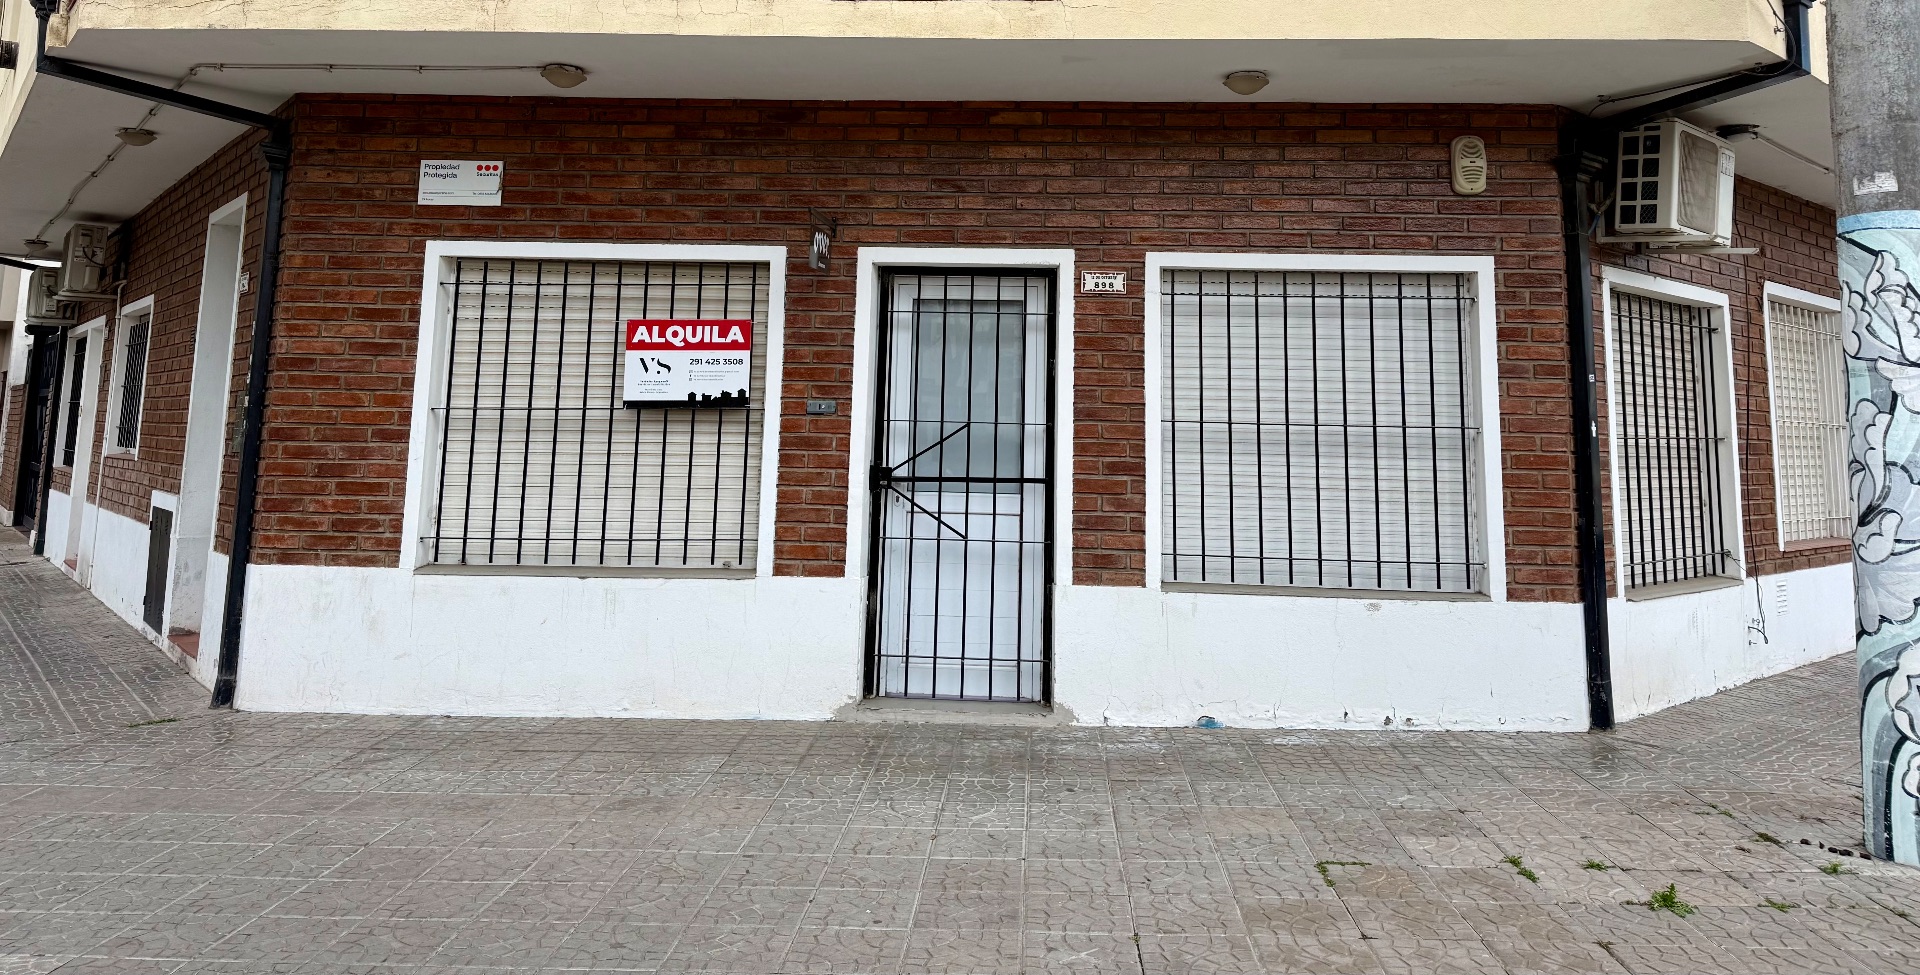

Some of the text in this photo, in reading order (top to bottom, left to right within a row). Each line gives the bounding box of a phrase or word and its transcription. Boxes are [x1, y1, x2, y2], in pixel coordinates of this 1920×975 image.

[424, 163, 460, 171] Propiedad
[632, 325, 745, 347] ALQUILA
[689, 358, 744, 366] 291 425 3508
